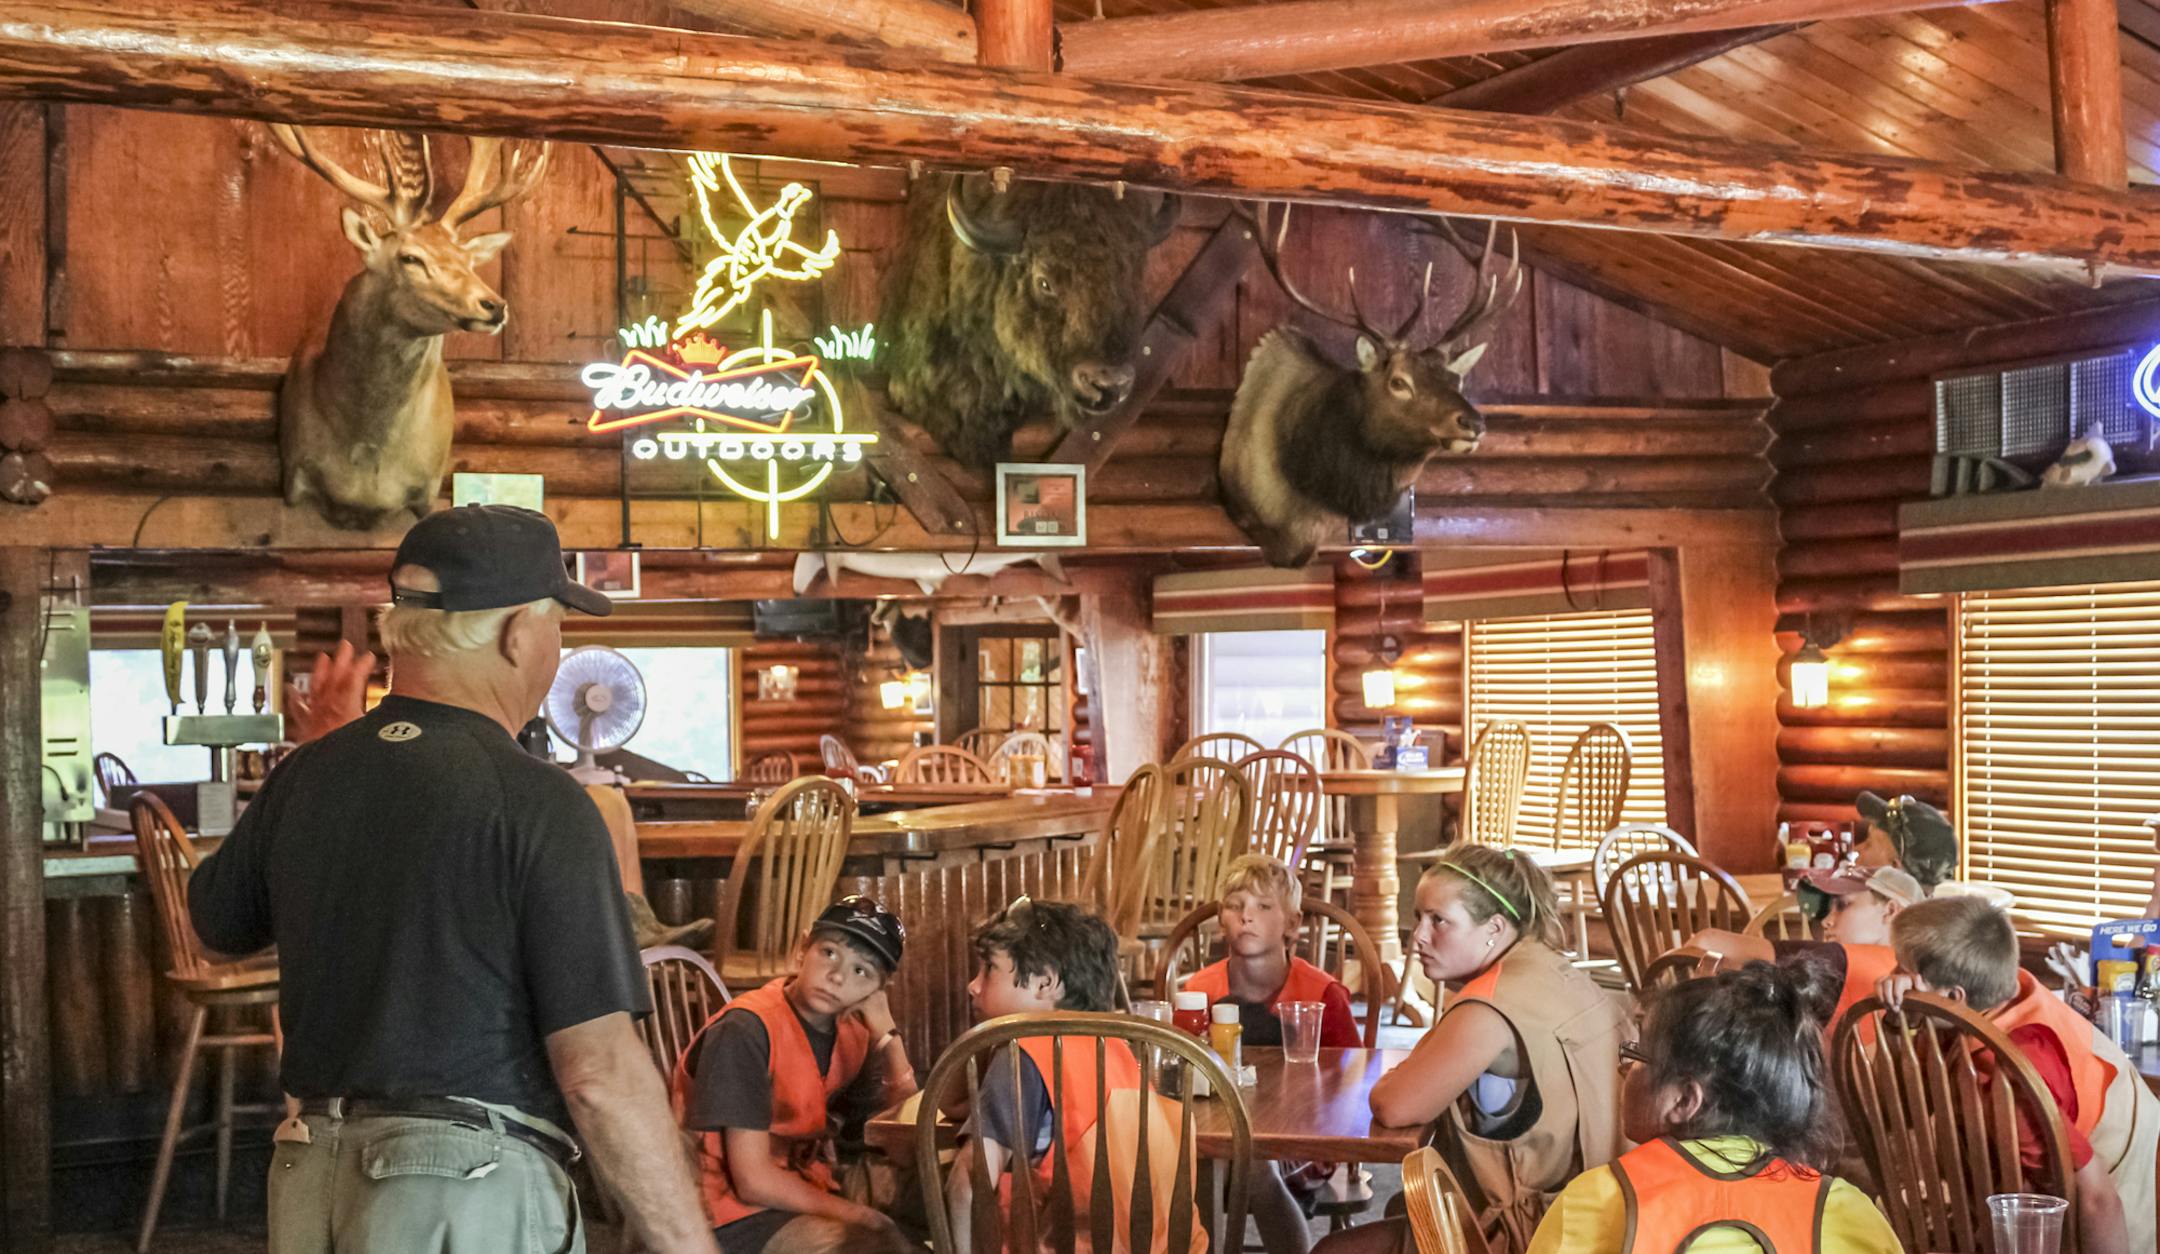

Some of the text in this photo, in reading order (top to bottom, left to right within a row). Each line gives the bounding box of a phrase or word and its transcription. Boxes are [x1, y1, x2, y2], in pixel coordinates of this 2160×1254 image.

[582, 363, 815, 410] Budweiser
[632, 438, 863, 462] OUTDOORS
[2099, 923, 2157, 935] HERE WE GO
